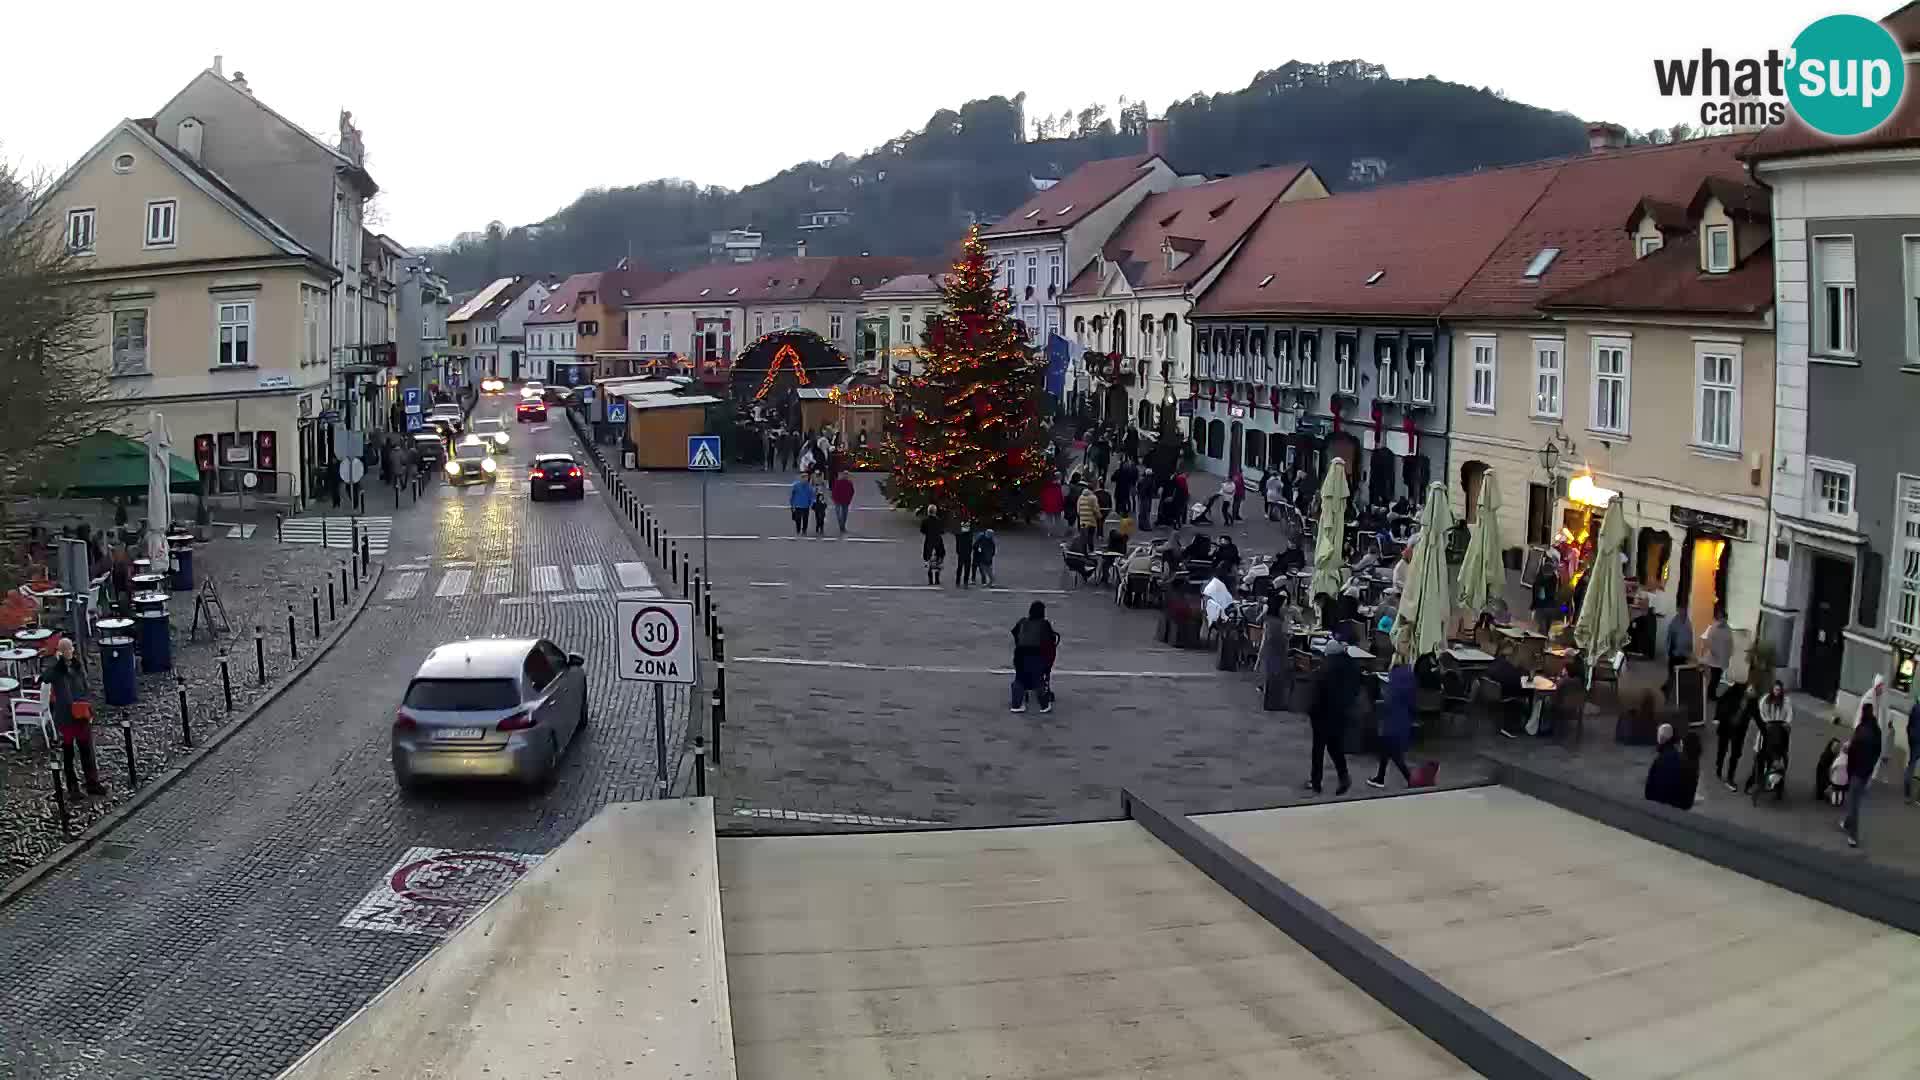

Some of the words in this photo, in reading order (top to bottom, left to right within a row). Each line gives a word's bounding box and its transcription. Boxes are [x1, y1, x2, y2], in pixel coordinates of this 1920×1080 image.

[408, 391, 416, 402] P
[643, 622, 668, 643] 30
[634, 659, 678, 676] ZONA
